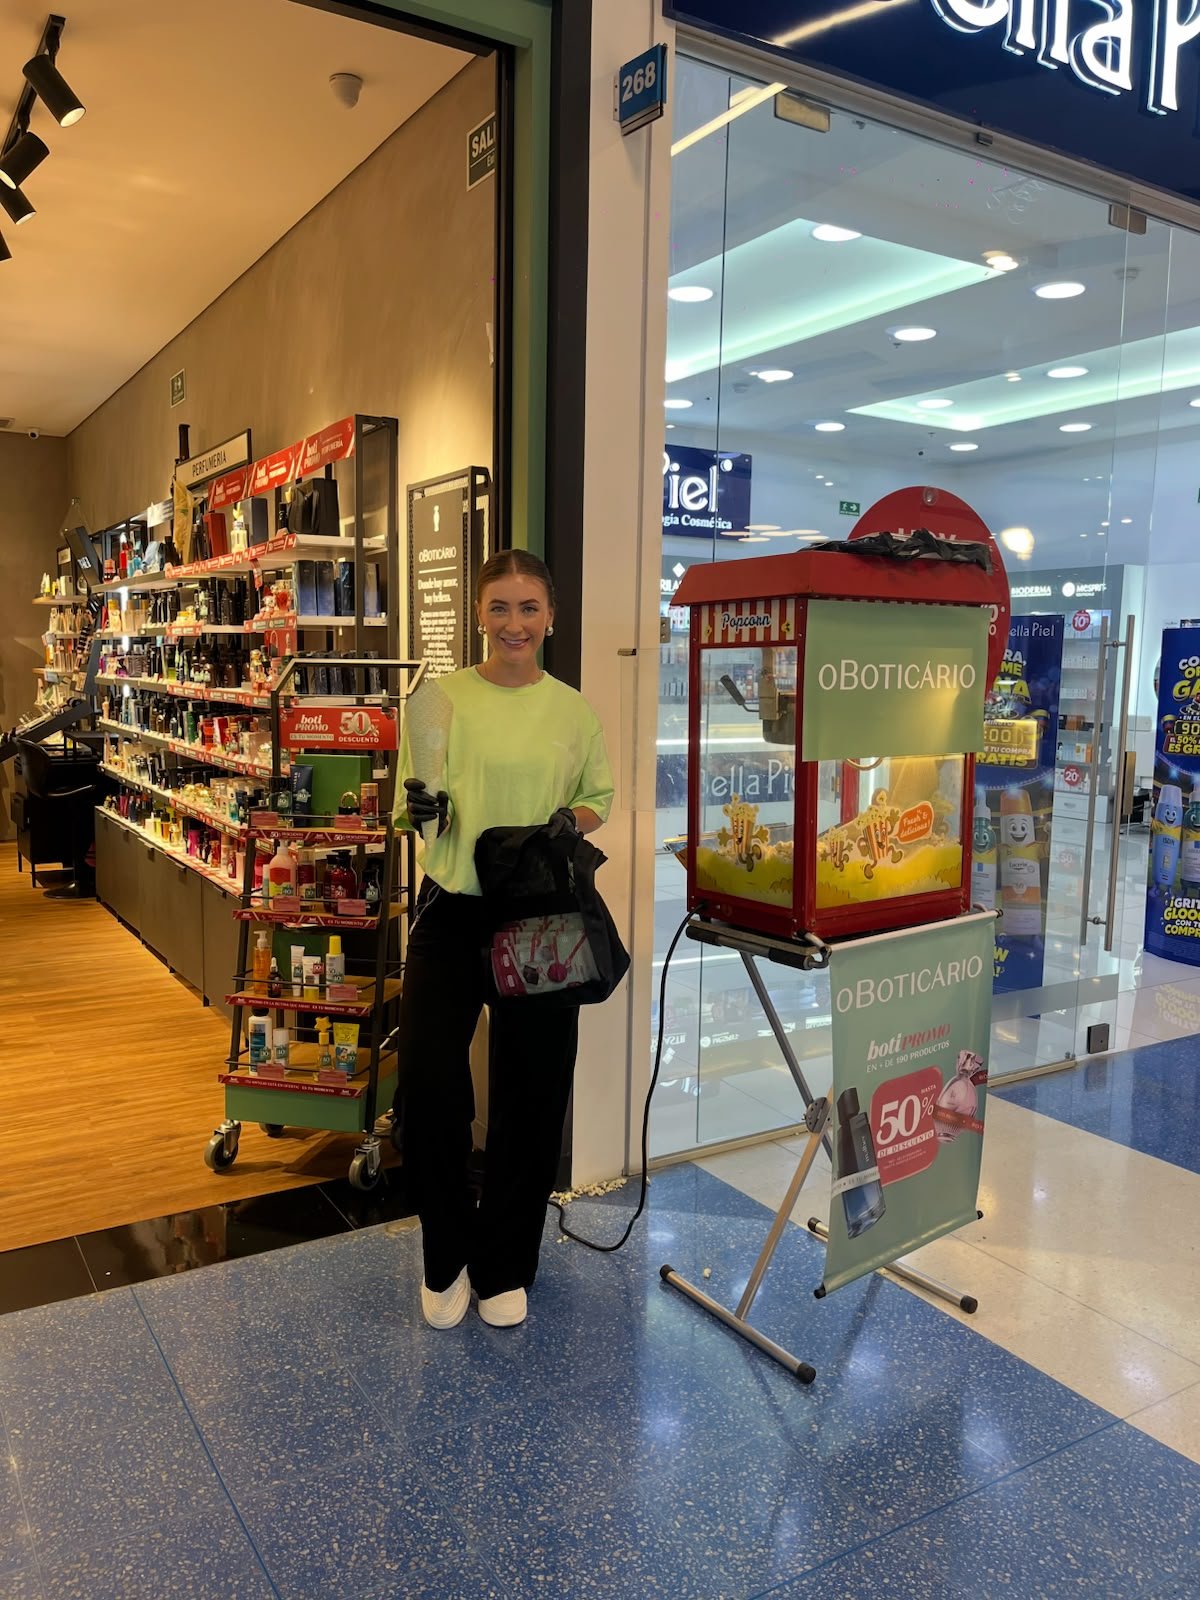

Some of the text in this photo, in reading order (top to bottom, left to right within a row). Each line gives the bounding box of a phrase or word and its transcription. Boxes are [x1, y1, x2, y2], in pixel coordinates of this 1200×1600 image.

[622, 61, 655, 103] 268
[722, 612, 771, 634] Popcorn
[1009, 621, 1055, 637] ella Piel
[295, 723, 328, 732] PROMO
[300, 714, 322, 724] boti
[340, 711, 379, 737] 50%
[1168, 744, 1181, 752] ES
[976, 752, 1028, 767] RATIS
[867, 1023, 951, 1061] boti PROMO
[866, 1062, 878, 1073] EN
[909, 1040, 950, 1061] PRODUCTOS
